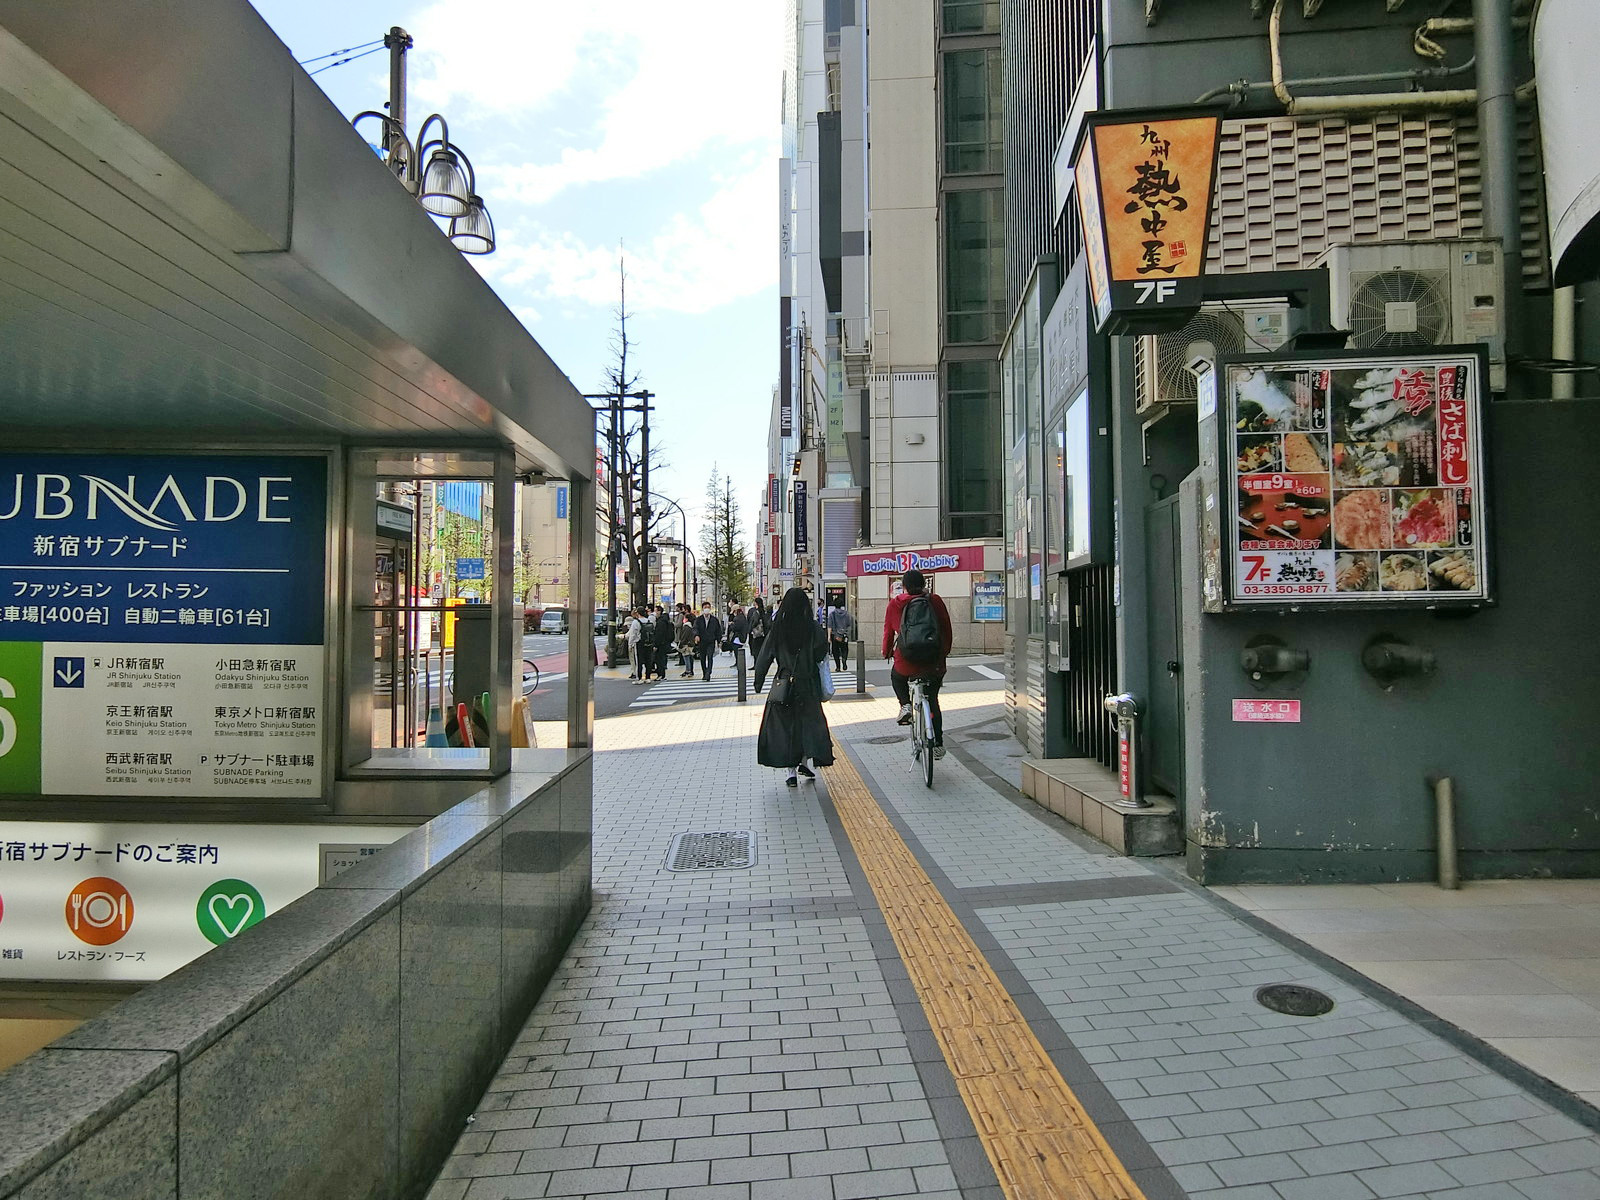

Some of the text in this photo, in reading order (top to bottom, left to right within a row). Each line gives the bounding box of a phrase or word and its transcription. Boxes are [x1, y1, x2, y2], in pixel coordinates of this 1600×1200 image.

[1134, 281, 1177, 304] 7F
[781, 406, 791, 429] MUJI
[795, 482, 804, 493] P
[33, 535, 188, 557] 新宿サブナード
[863, 560, 897, 573] baskin
[919, 555, 958, 570] robbins
[1242, 556, 1271, 581] 7F
[12, 581, 209, 600] ファッション レストラン
[1244, 586, 1328, 594] 03-3350-8877
[0, 606, 270, 627] 車場[400台] 自動二輪車[61台]
[107, 657, 165, 669] JR新宿駅
[215, 658, 296, 671] 小田急新宿駅
[119, 672, 152, 680] Shinjuku
[154, 672, 181, 680] Station
[215, 674, 244, 682] Odakyu
[246, 674, 280, 682] Shinjuku
[106, 705, 173, 718] 京王新宿駅
[214, 706, 316, 719] 東京メトロ新宿駅
[124, 720, 158, 728] Shinjuku
[160, 720, 187, 728] Station
[214, 721, 235, 729] Tokyo
[260, 722, 290, 730] Shinjuku
[105, 752, 173, 765] 西武新宿駅
[214, 753, 315, 767] サブナード駐車場
[129, 767, 162, 775] Shinjuku
[255, 769, 284, 777] Parking
[0, 841, 219, 864] 宿サブナードのご案内
[57, 951, 146, 962] レストラン・フーズ
